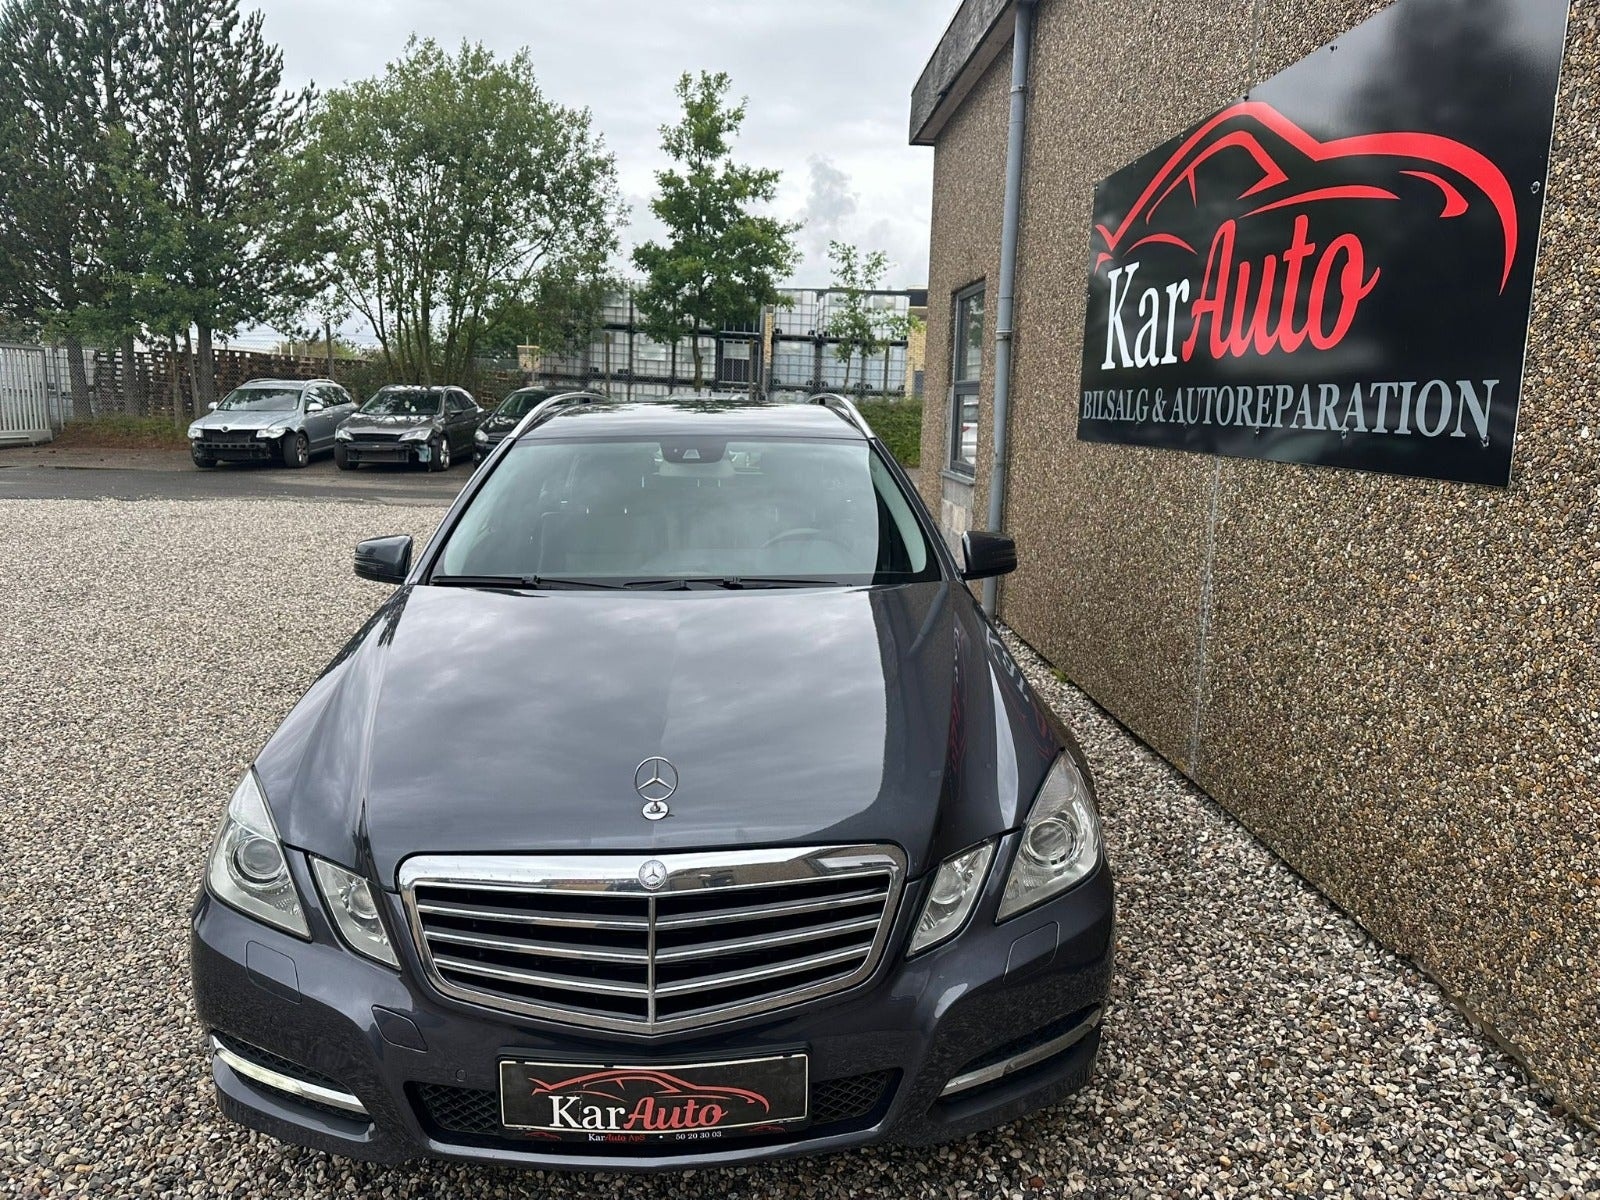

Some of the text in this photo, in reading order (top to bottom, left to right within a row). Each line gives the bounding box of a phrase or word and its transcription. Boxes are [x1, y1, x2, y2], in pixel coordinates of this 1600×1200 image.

[1101, 214, 1381, 370] KarAuto
[1082, 379, 1500, 438] BILSALG & AUTOREPARATION
[548, 1095, 729, 1130] KarAuto
[588, 1133, 626, 1142] KarAuto
[711, 1130, 722, 1138] 03
